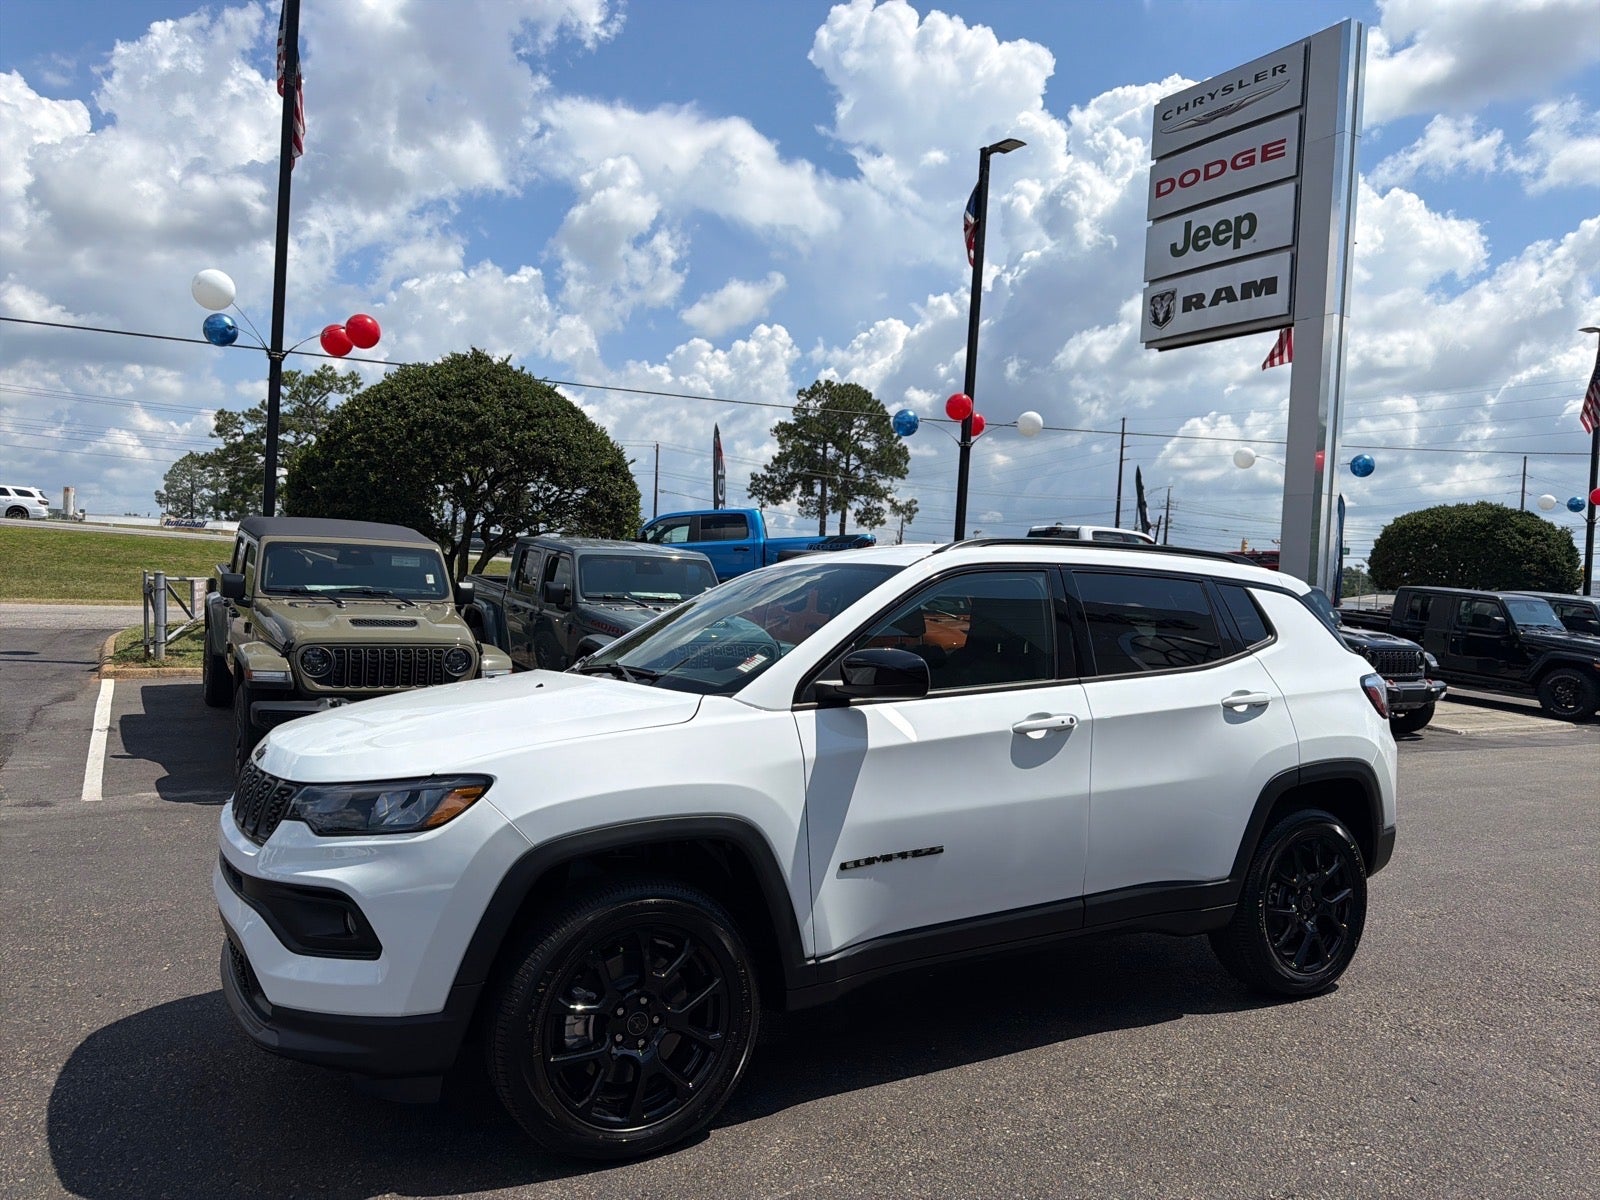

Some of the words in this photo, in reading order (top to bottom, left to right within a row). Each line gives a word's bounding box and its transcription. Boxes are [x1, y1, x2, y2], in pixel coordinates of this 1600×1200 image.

[1162, 63, 1287, 122] CHRYSLER
[1155, 138, 1287, 199] DODGE
[1170, 212, 1258, 258] Jeep
[1181, 276, 1278, 314] RAM
